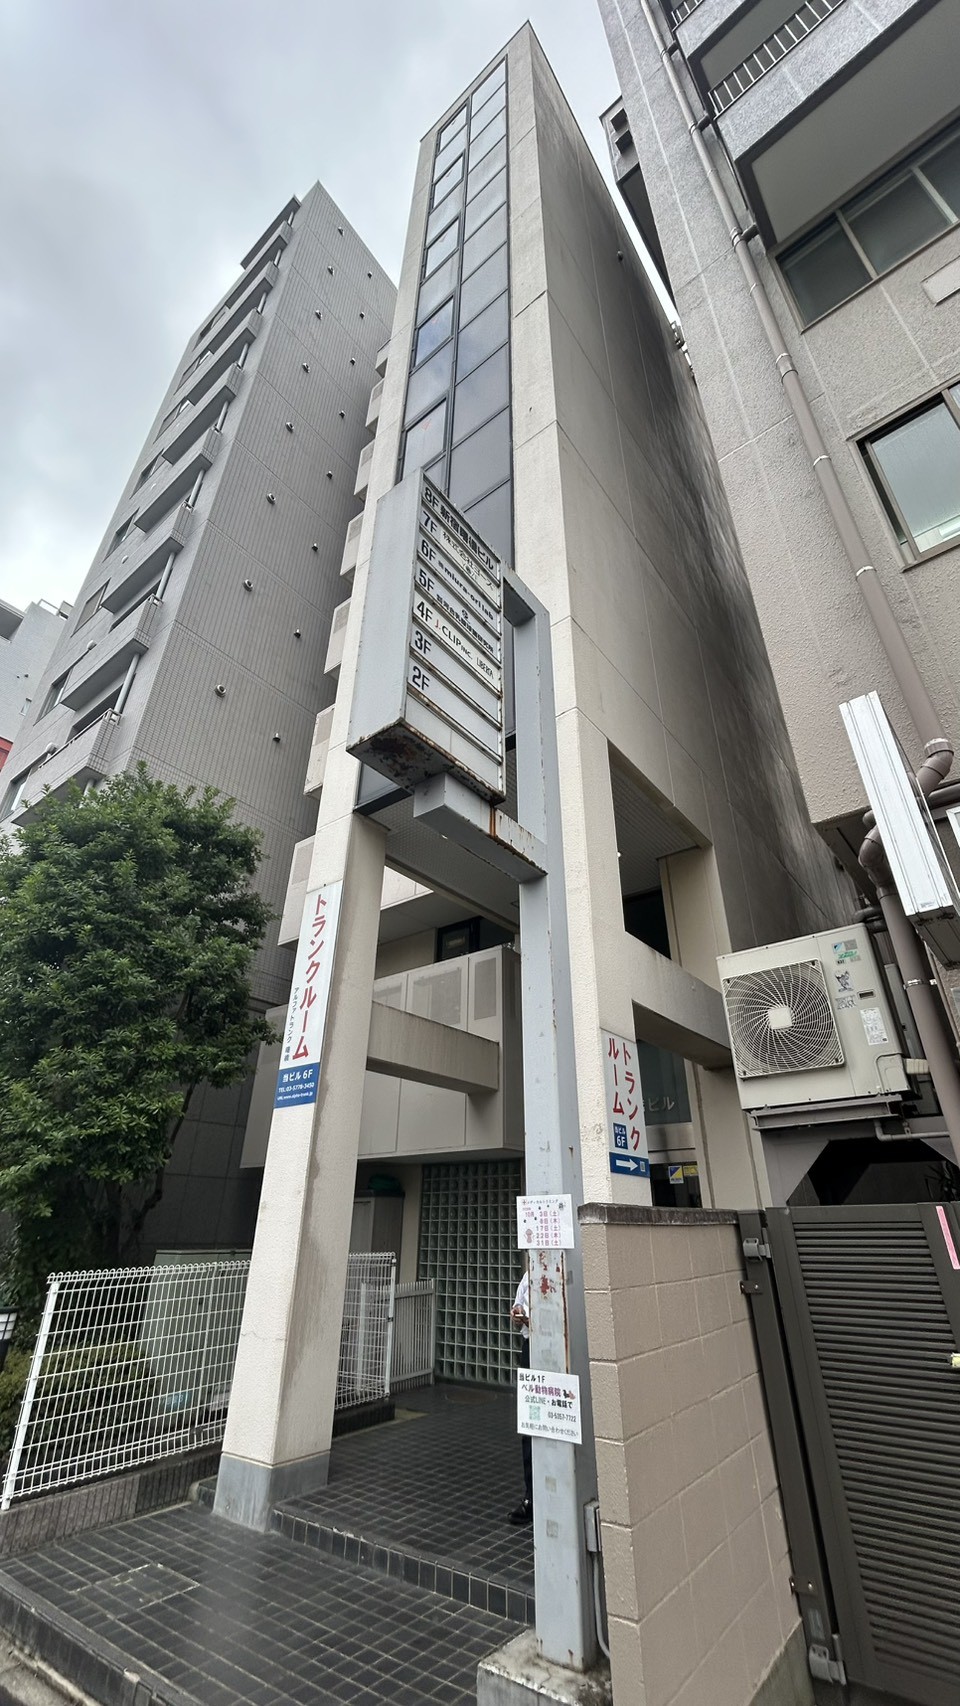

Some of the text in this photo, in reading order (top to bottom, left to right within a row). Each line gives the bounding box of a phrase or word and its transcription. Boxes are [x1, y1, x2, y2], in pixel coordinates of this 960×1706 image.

[425, 487, 439, 508] 8F
[423, 511, 437, 533] 7F
[421, 540, 436, 561] 6F
[419, 569, 434, 591] 5F
[417, 601, 432, 622] 4F
[415, 630, 432, 654] 3F
[412, 665, 430, 691] 2F
[292, 893, 327, 1060] トランクルーム
[302, 1069, 313, 1080] 6F
[608, 1037, 625, 1115] ルーム
[623, 1042, 641, 1151] トランク
[616, 1135, 626, 1147] 6F
